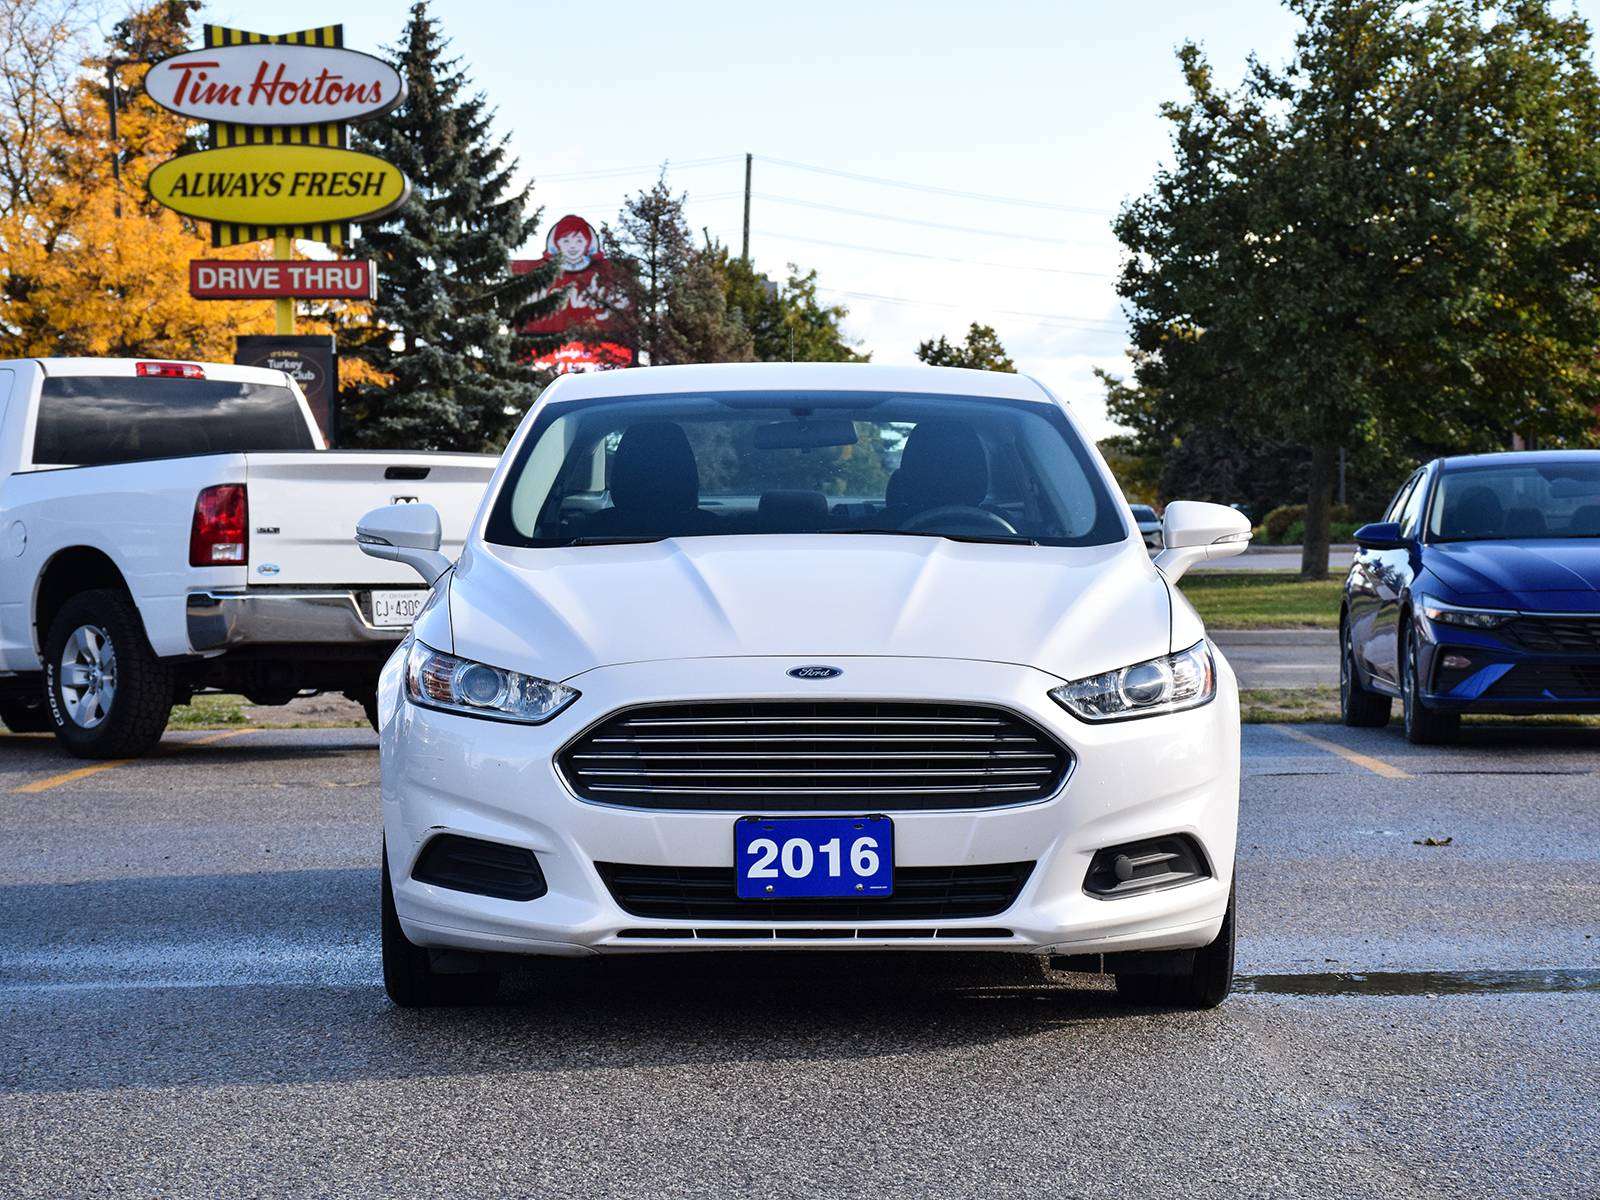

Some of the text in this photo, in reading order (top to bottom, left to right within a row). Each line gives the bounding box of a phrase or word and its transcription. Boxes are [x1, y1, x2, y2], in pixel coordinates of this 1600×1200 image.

[168, 60, 382, 107] Tim Hortons
[168, 171, 386, 197] ALWAYS FRESH
[198, 267, 363, 289] DRIVE THRU
[267, 359, 303, 370] Turkey
[291, 370, 316, 380] Club
[799, 668, 830, 677] Ford
[47, 663, 65, 727] COOPER
[747, 837, 879, 878] 2016
